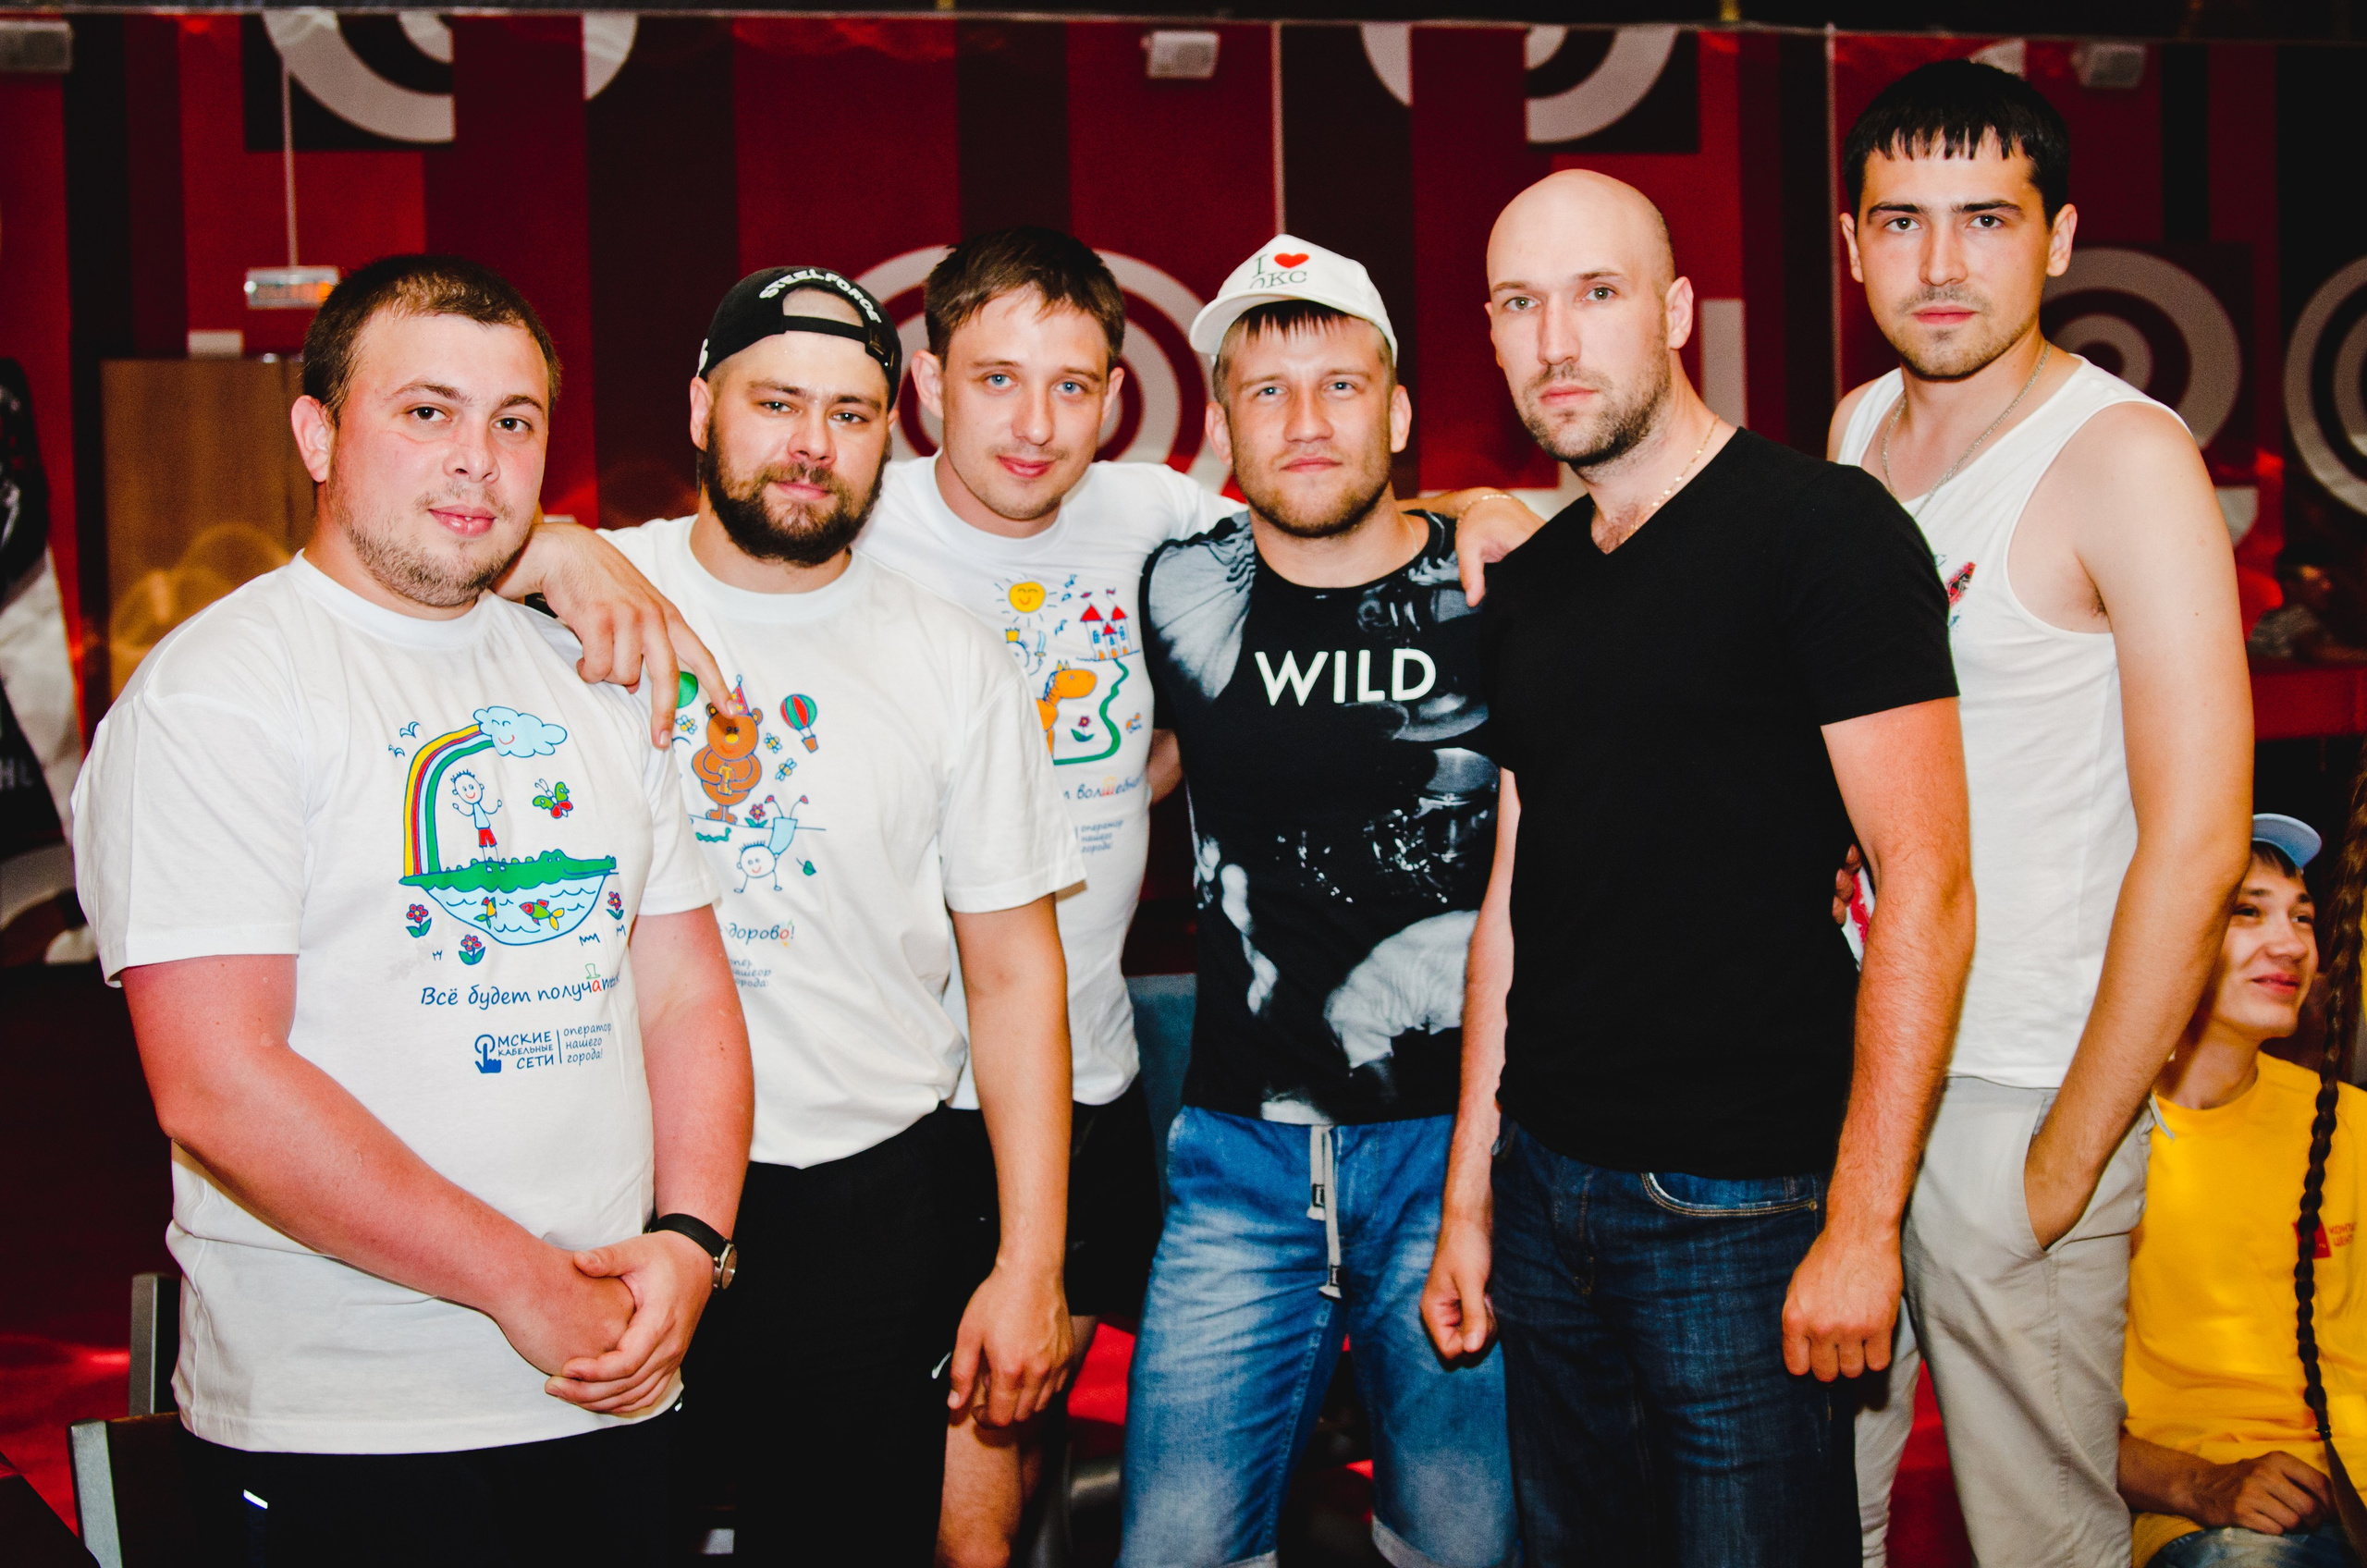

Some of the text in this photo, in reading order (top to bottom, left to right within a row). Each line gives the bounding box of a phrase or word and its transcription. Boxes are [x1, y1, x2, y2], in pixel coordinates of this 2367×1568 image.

[759, 268, 882, 324] STEELFORCE
[1254, 648, 1437, 707] WILD
[725, 922, 794, 945] дорово!
[421, 986, 459, 1006] Всё
[468, 984, 532, 1011] будет
[563, 1023, 612, 1038] оператор
[497, 1044, 553, 1057] КАБЕЛЬНЫЕ
[565, 1037, 603, 1050] нашего
[516, 1054, 554, 1070] СЕТИ
[567, 1047, 604, 1066] города!
